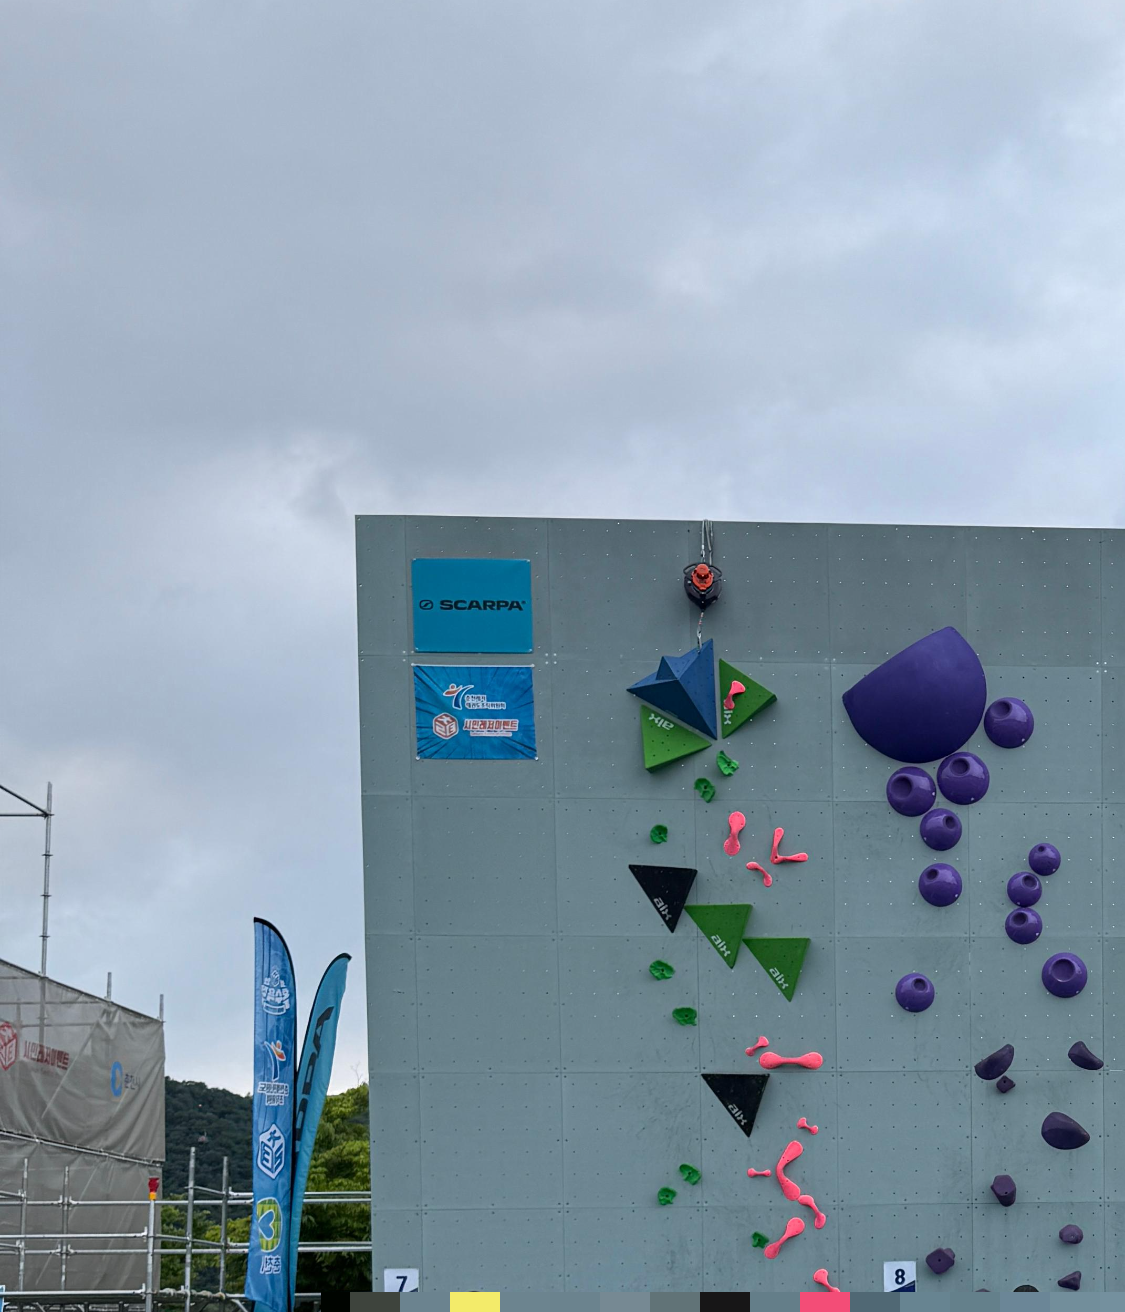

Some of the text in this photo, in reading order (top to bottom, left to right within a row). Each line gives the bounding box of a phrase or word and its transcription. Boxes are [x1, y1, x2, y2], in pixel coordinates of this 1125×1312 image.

[440, 600, 523, 611] SCARPA
[396, 1275, 408, 1292] 7
[894, 1268, 906, 1285] 8
